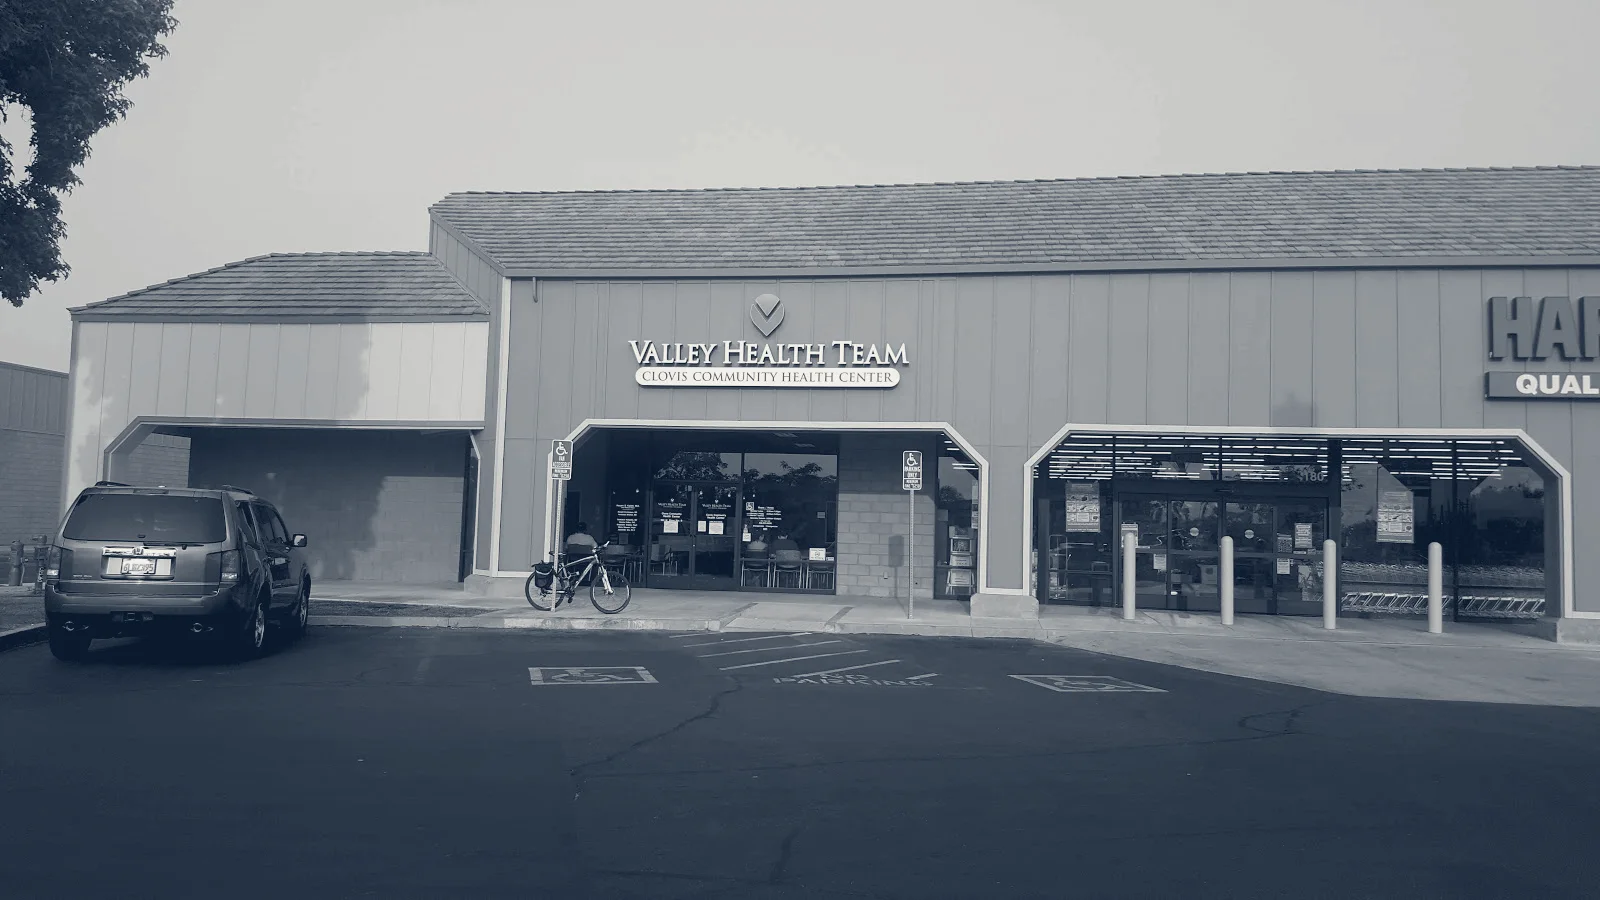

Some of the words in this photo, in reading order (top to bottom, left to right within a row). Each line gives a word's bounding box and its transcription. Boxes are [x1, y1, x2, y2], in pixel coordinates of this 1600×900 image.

[628, 340, 717, 365] VALLEY
[722, 340, 826, 366] HEALTH
[832, 340, 910, 366] TEAM
[642, 371, 688, 382] CLOVIS
[692, 371, 778, 383] COMMUNITY
[781, 372, 834, 383] HEALTH
[838, 373, 893, 384] CENTER
[1515, 373, 1600, 395] QUAL
[773, 677, 935, 687] PARKING
